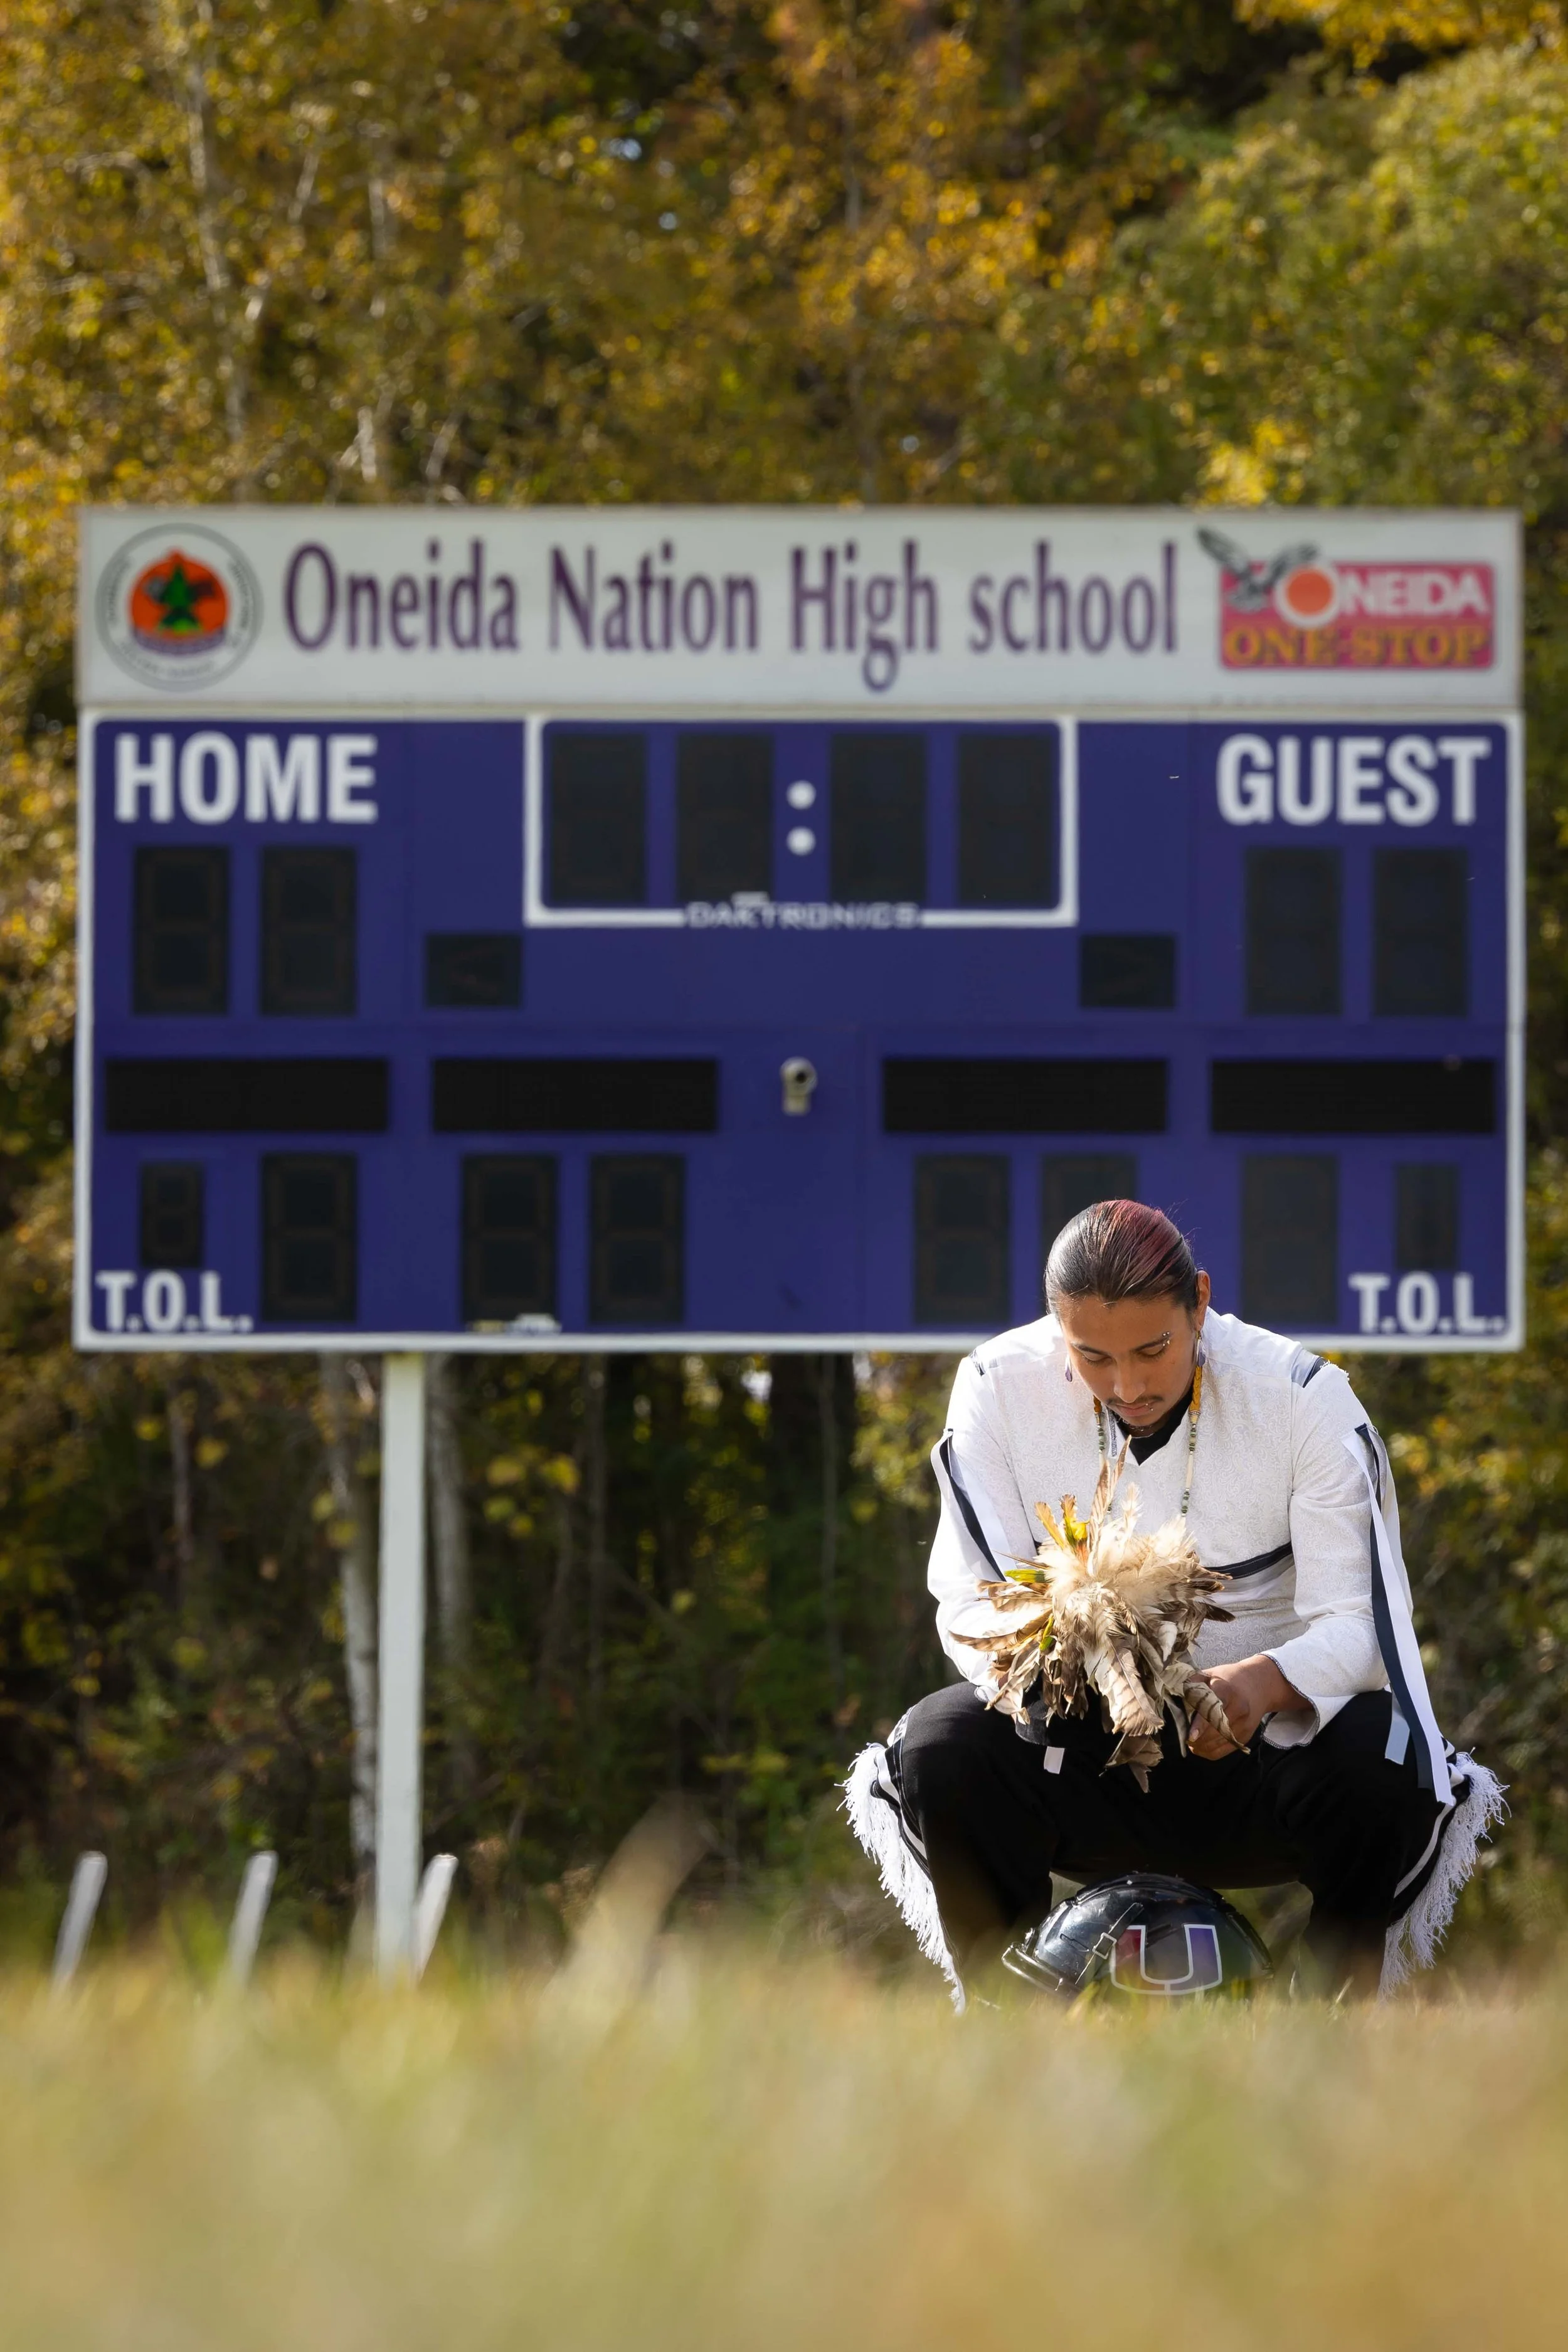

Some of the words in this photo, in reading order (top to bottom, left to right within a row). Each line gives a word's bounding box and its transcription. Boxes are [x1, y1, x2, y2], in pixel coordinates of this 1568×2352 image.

[284, 538, 517, 654] Oneida
[549, 541, 758, 654] Nation
[789, 538, 937, 692] High
[968, 539, 1177, 654] school
[1274, 564, 1490, 630] ONEIDA
[1224, 628, 1335, 665] ONE
[1350, 628, 1486, 665] STOP
[114, 731, 378, 824] HOME
[1216, 733, 1491, 827] GUEST
[686, 901, 919, 930] DAKTRONICS
[95, 1269, 253, 1333] T.O.L.
[1348, 1271, 1504, 1335] T.O.L.
[1110, 1924, 1222, 1995] U
